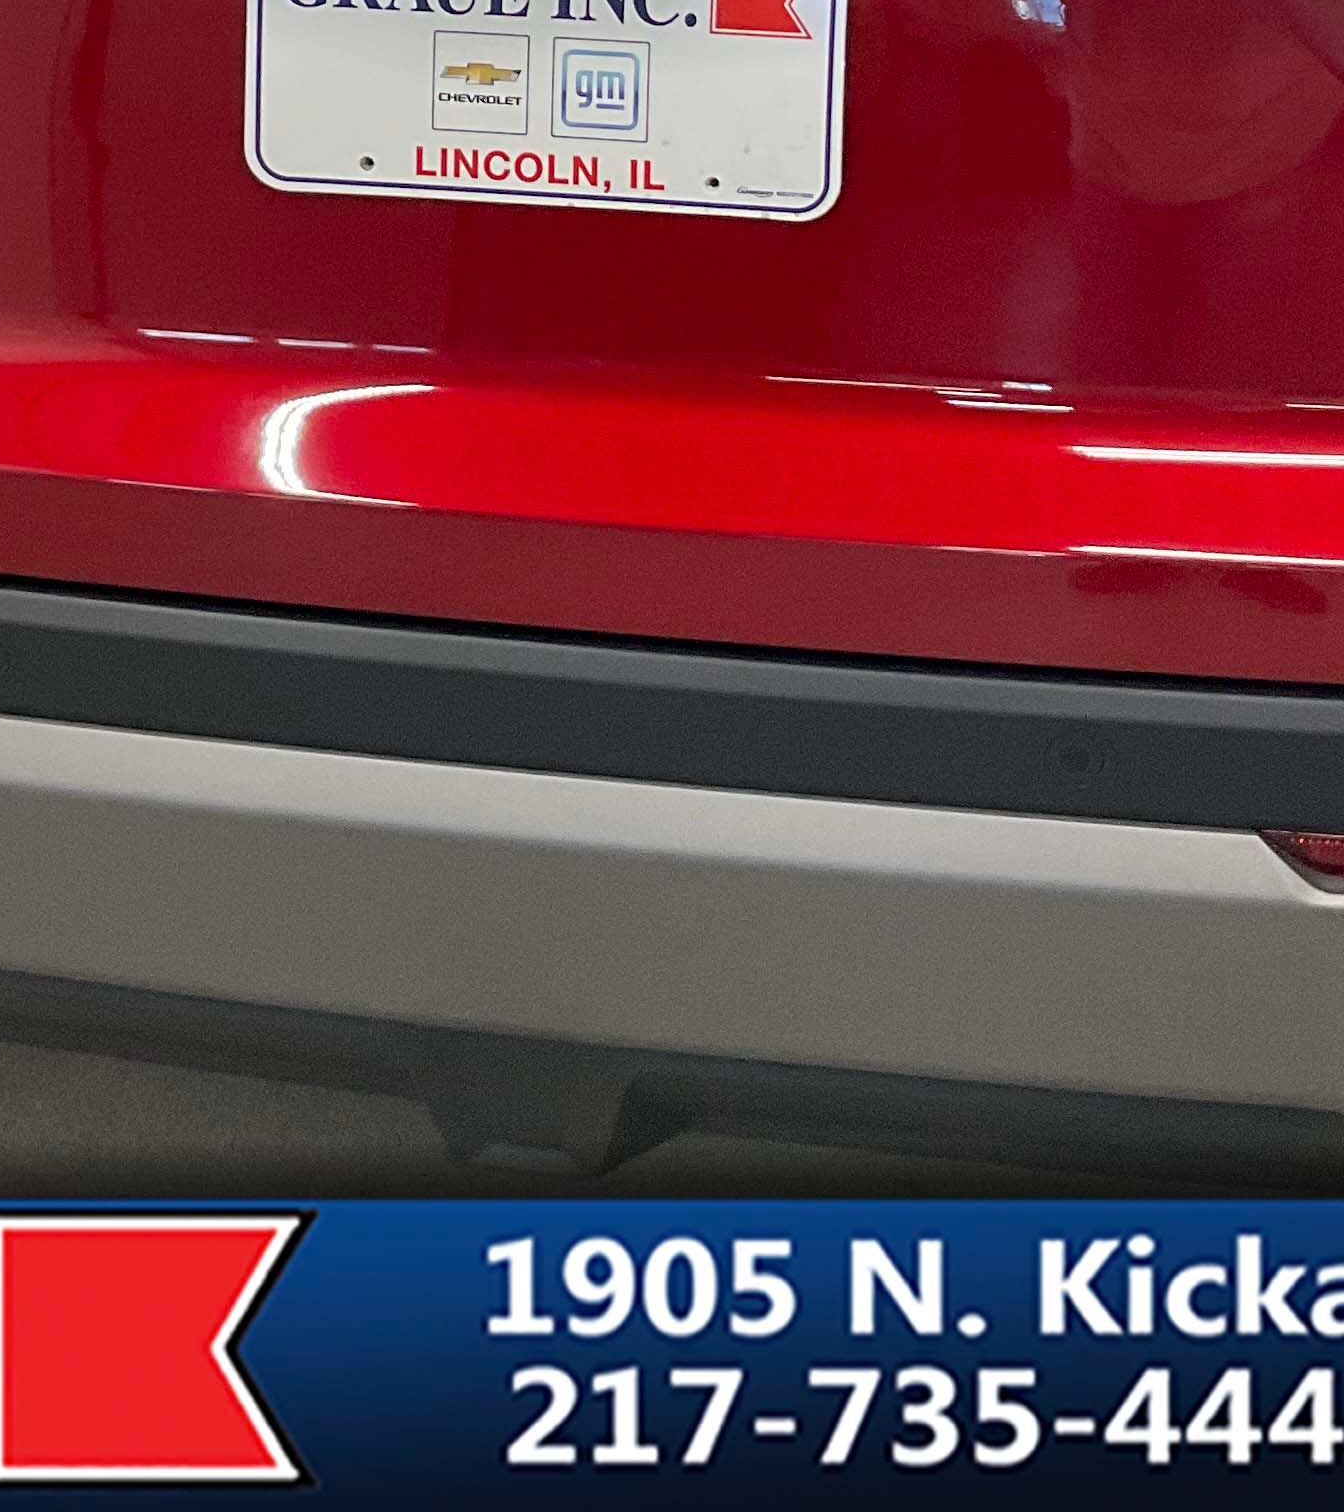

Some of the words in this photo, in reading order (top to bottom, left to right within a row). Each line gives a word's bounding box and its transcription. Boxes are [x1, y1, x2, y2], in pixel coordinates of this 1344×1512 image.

[438, 92, 523, 107] CHEVROLET
[575, 69, 626, 109] gm
[415, 146, 612, 194] LINCOLN,
[630, 159, 665, 191] IL
